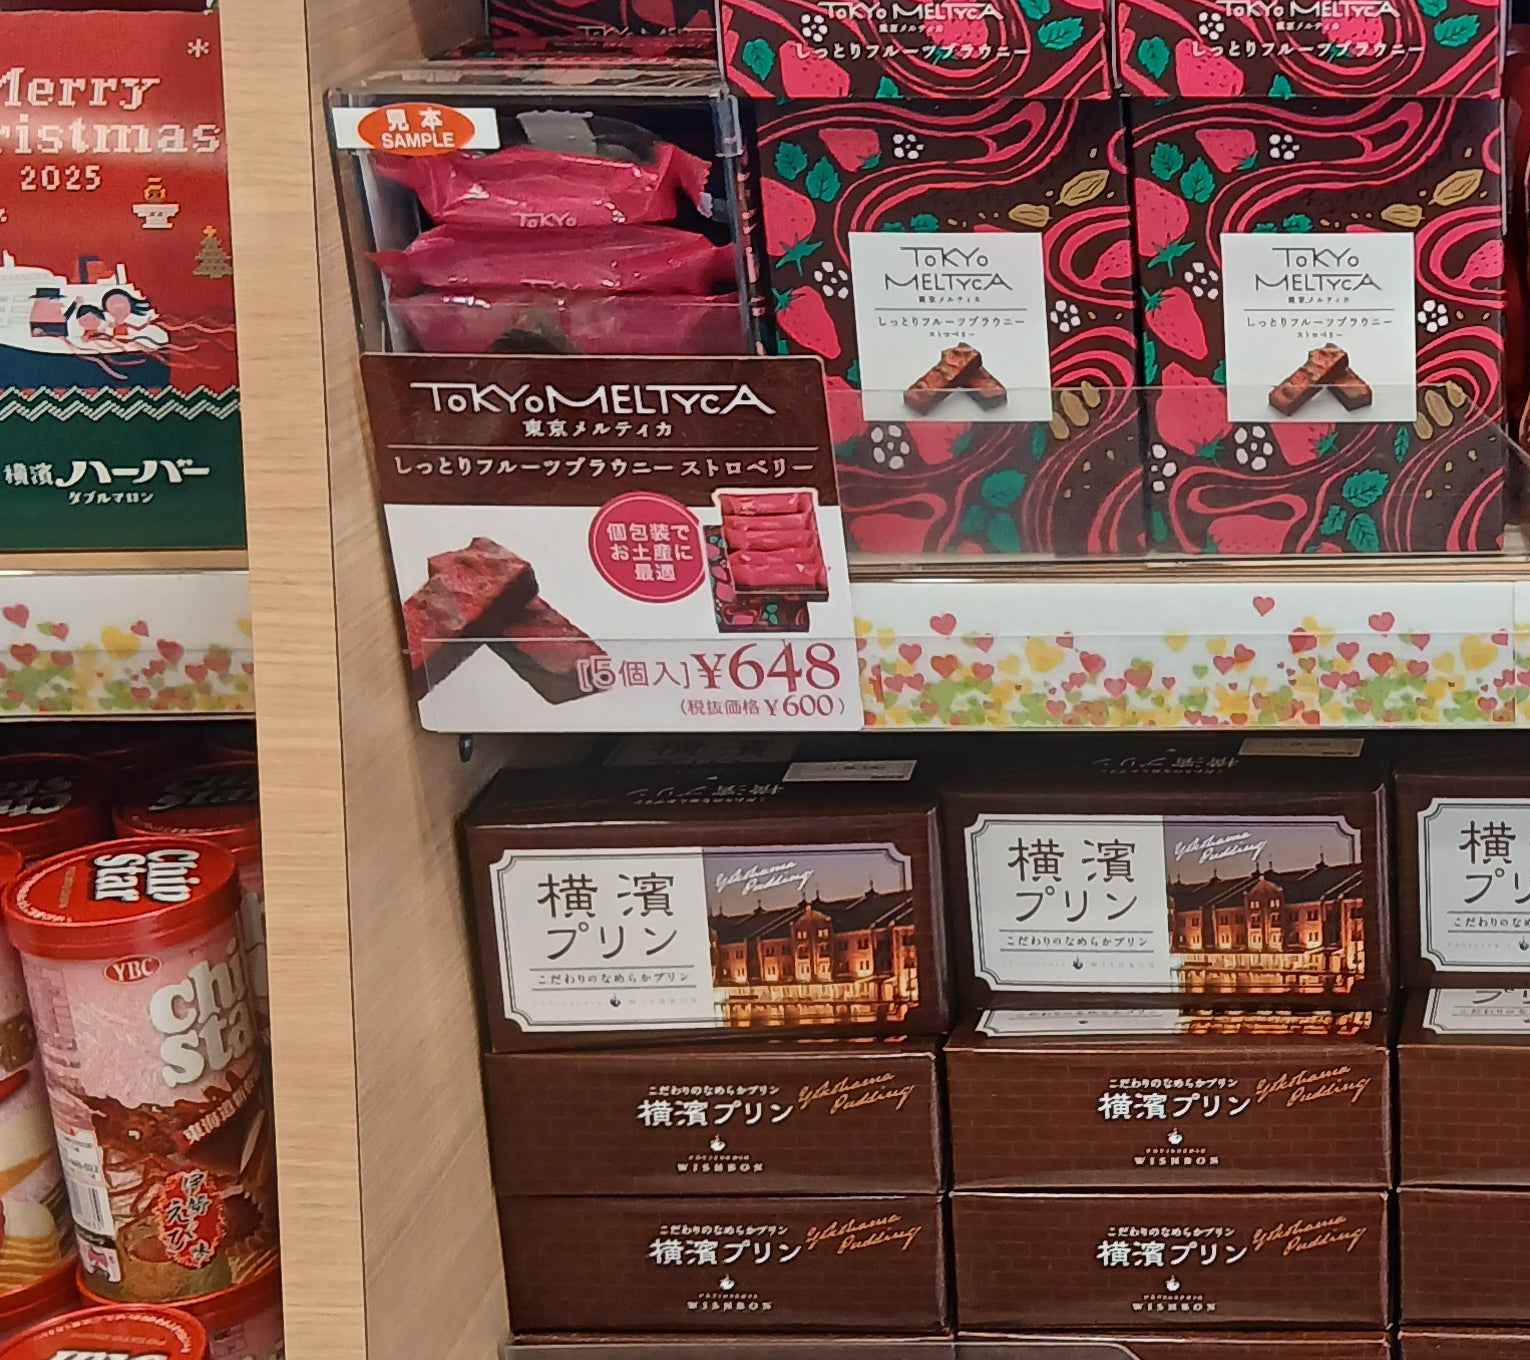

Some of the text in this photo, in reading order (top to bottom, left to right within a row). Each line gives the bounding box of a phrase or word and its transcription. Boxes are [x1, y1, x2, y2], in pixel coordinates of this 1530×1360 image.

[794, 42, 1031, 61] しっとりフルーツブラウニー
[1190, 40, 1427, 60] しっとりフルーツブラウニー
[385, 107, 444, 131] 見本
[380, 131, 456, 149] SAMPLE
[20, 164, 102, 191] 2025
[878, 316, 1026, 328] しっとりフルーツブラウニー
[1246, 316, 1393, 328] しっとりフルーツブラウニー
[523, 420, 673, 439] 東京メルティカ
[3, 457, 211, 488] 横濱ハーバー
[393, 456, 815, 478] しっとりフルーツブラウニー ストロベリー
[68, 490, 155, 506] ダブルマロン
[606, 522, 691, 543] 個包装で
[610, 544, 694, 563] お土産に
[634, 563, 677, 582] 最適
[1007, 837, 1136, 883] 横濱
[537, 872, 676, 919] 横濱
[1015, 885, 1139, 923] プリン
[546, 923, 678, 961] プリン
[112, 958, 154, 982] YBC
[636, 1099, 794, 1127] 横濱プリン
[1097, 1093, 1252, 1120] 横濱プリン
[648, 1238, 803, 1266] 横濱プリン
